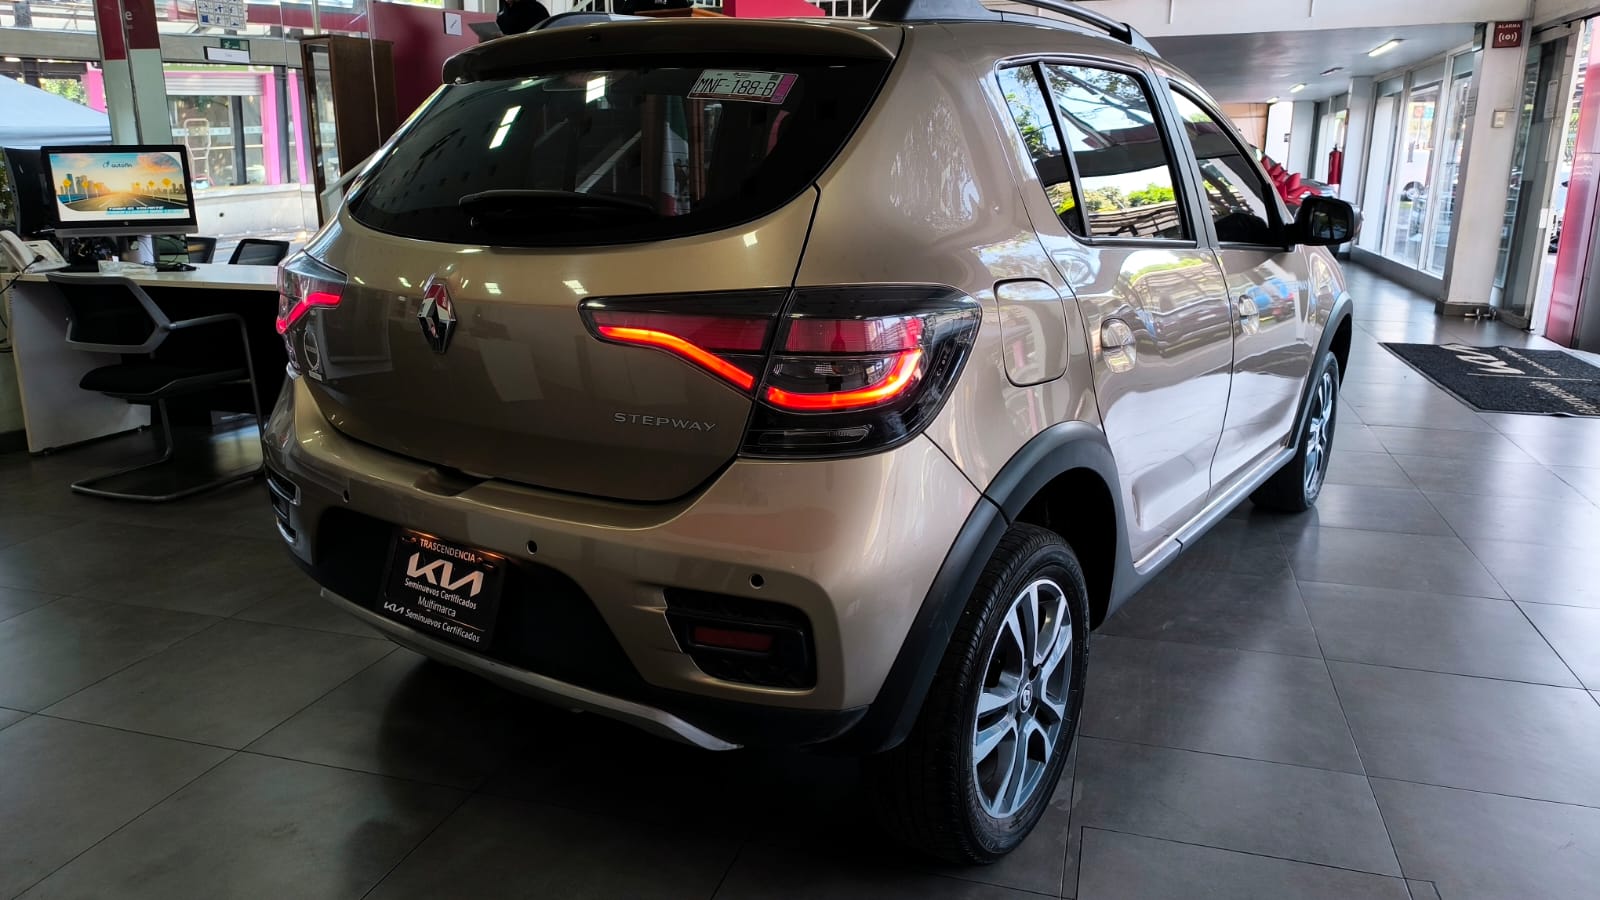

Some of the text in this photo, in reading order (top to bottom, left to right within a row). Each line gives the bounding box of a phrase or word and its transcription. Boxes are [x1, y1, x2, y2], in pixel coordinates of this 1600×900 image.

[614, 412, 716, 431] STEPWAY
[420, 538, 475, 563] TRASCENDENCIA
[406, 551, 484, 597] KIA
[404, 578, 477, 610] Seminuevos Certificados
[417, 595, 457, 617] Multimarca
[383, 601, 480, 643] KIA Seminuevos Certificados
